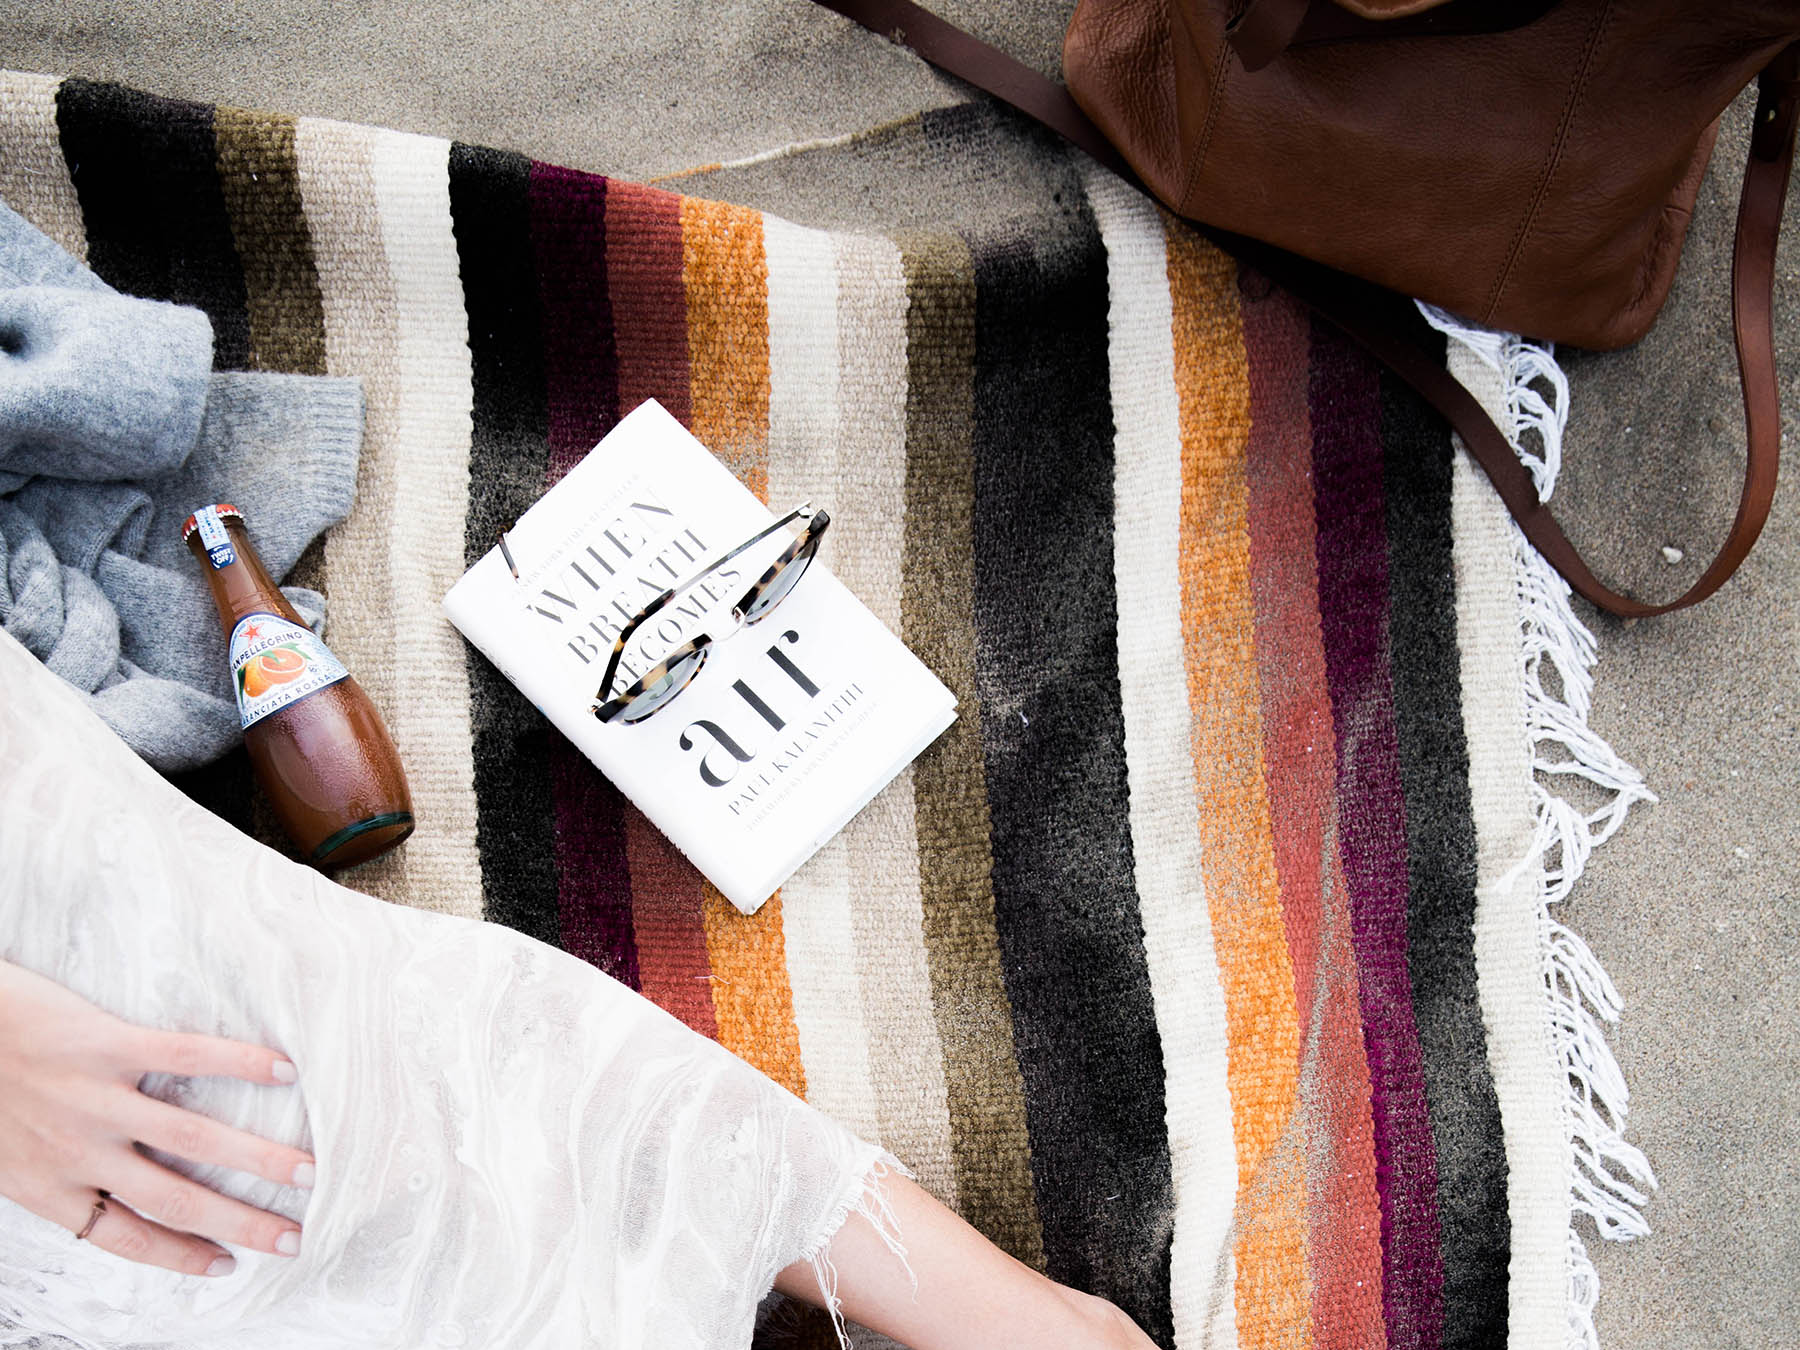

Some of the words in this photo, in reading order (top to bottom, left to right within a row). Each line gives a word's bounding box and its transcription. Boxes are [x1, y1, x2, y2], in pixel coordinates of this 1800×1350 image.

[210, 548, 232, 561] TWIST
[216, 553, 230, 564] OFF
[526, 487, 674, 625] WHEN
[567, 527, 708, 665] BREATH
[295, 673, 331, 695] ROSSA
[679, 629, 826, 788] air
[728, 773, 776, 816] PAUL
[771, 682, 864, 774] KALANITHI
